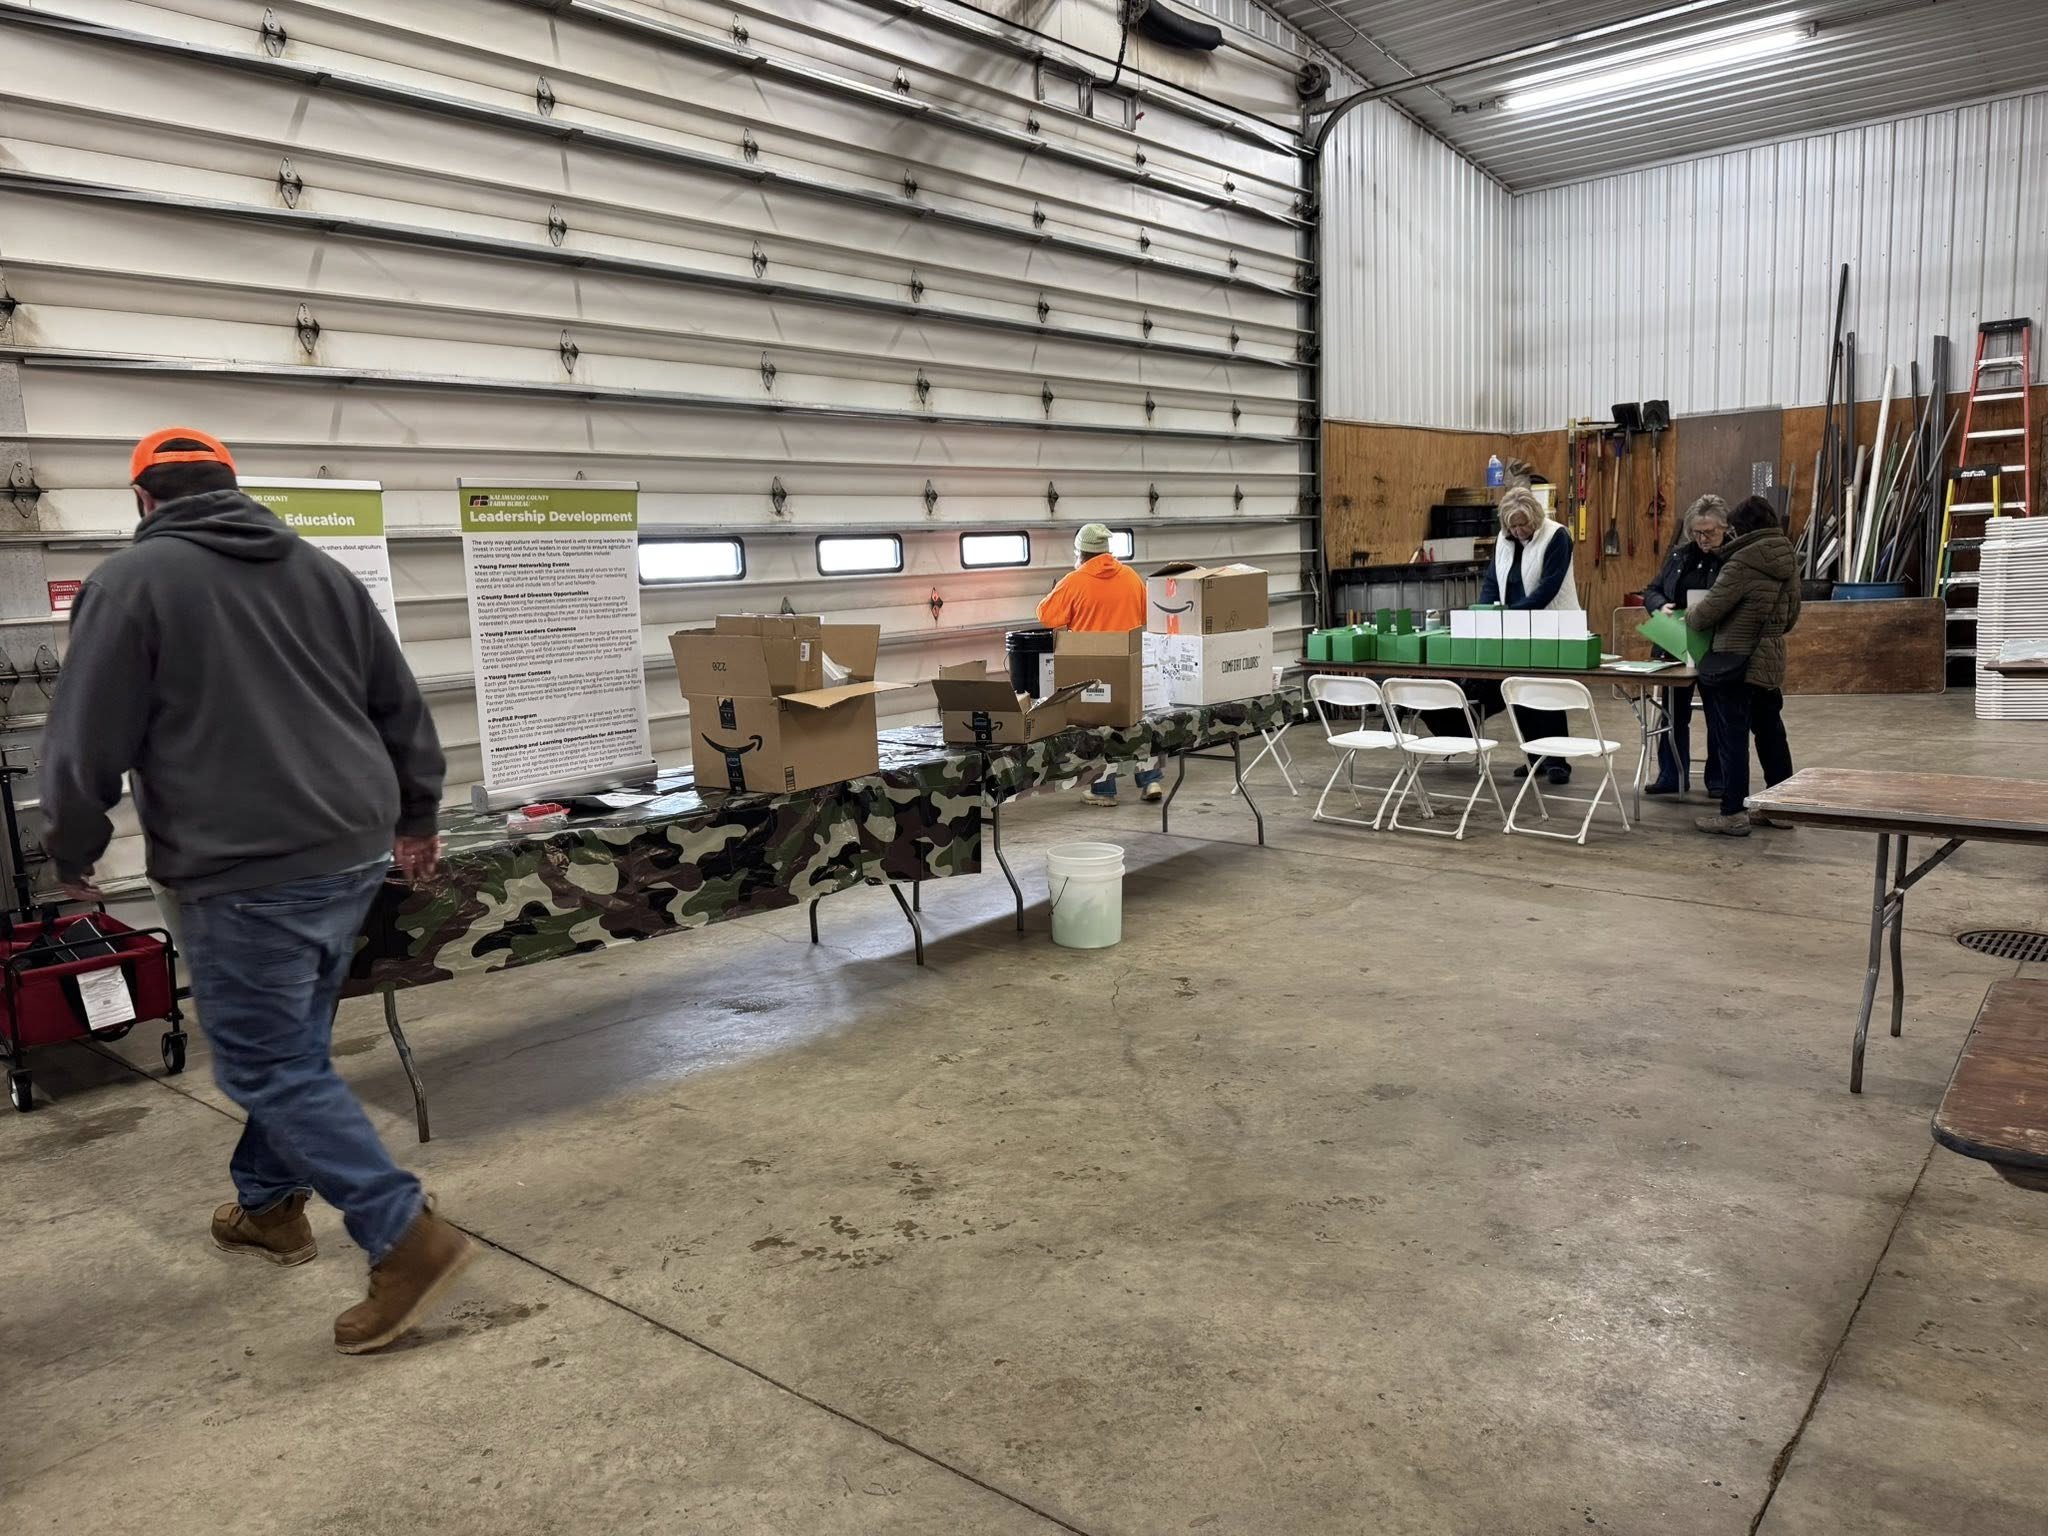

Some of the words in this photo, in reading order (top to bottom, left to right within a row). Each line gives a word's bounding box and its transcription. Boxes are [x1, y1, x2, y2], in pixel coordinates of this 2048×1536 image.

[286, 513, 356, 527] Education
[470, 511, 546, 524] Leadership
[549, 511, 633, 523] Development
[553, 590, 589, 598] Opportunities
[1221, 658, 1241, 673] COMFORT
[495, 744, 528, 752] Networking
[540, 738, 563, 746] Learning
[563, 733, 598, 743] Opportunities
